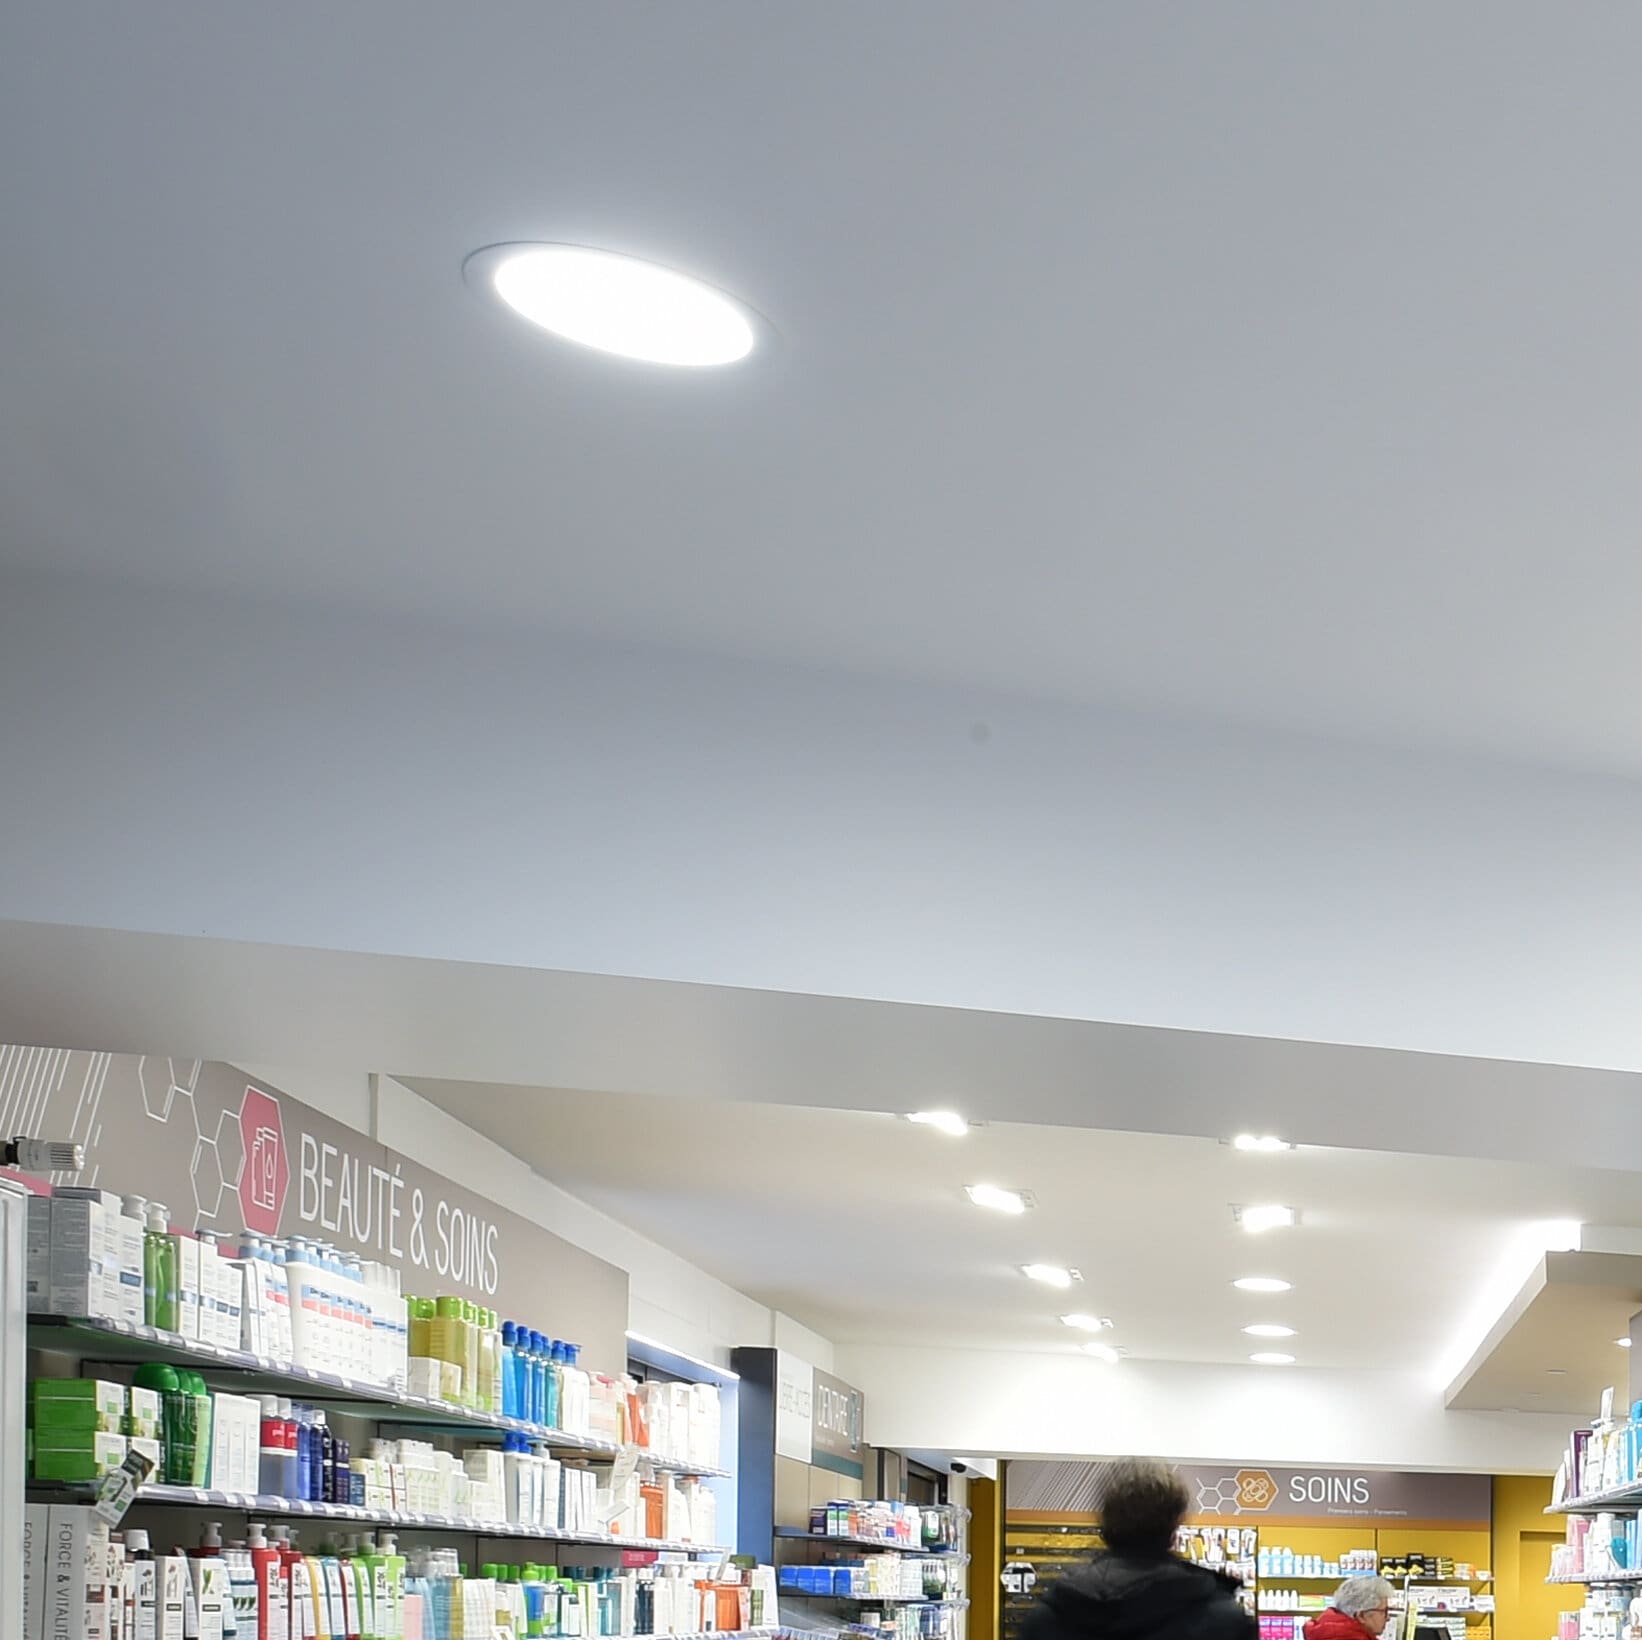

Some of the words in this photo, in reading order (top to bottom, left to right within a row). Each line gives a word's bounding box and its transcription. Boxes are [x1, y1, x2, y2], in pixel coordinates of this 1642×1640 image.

[301, 1132, 403, 1258] BEAUTÉ
[409, 1189, 429, 1268] &
[435, 1200, 499, 1295] SOINS
[1289, 1476, 1369, 1504] SOINS
[58, 1523, 73, 1568] FORCE
[57, 1574, 70, 1582] &
[54, 1588, 70, 1640] VITALITÉ
